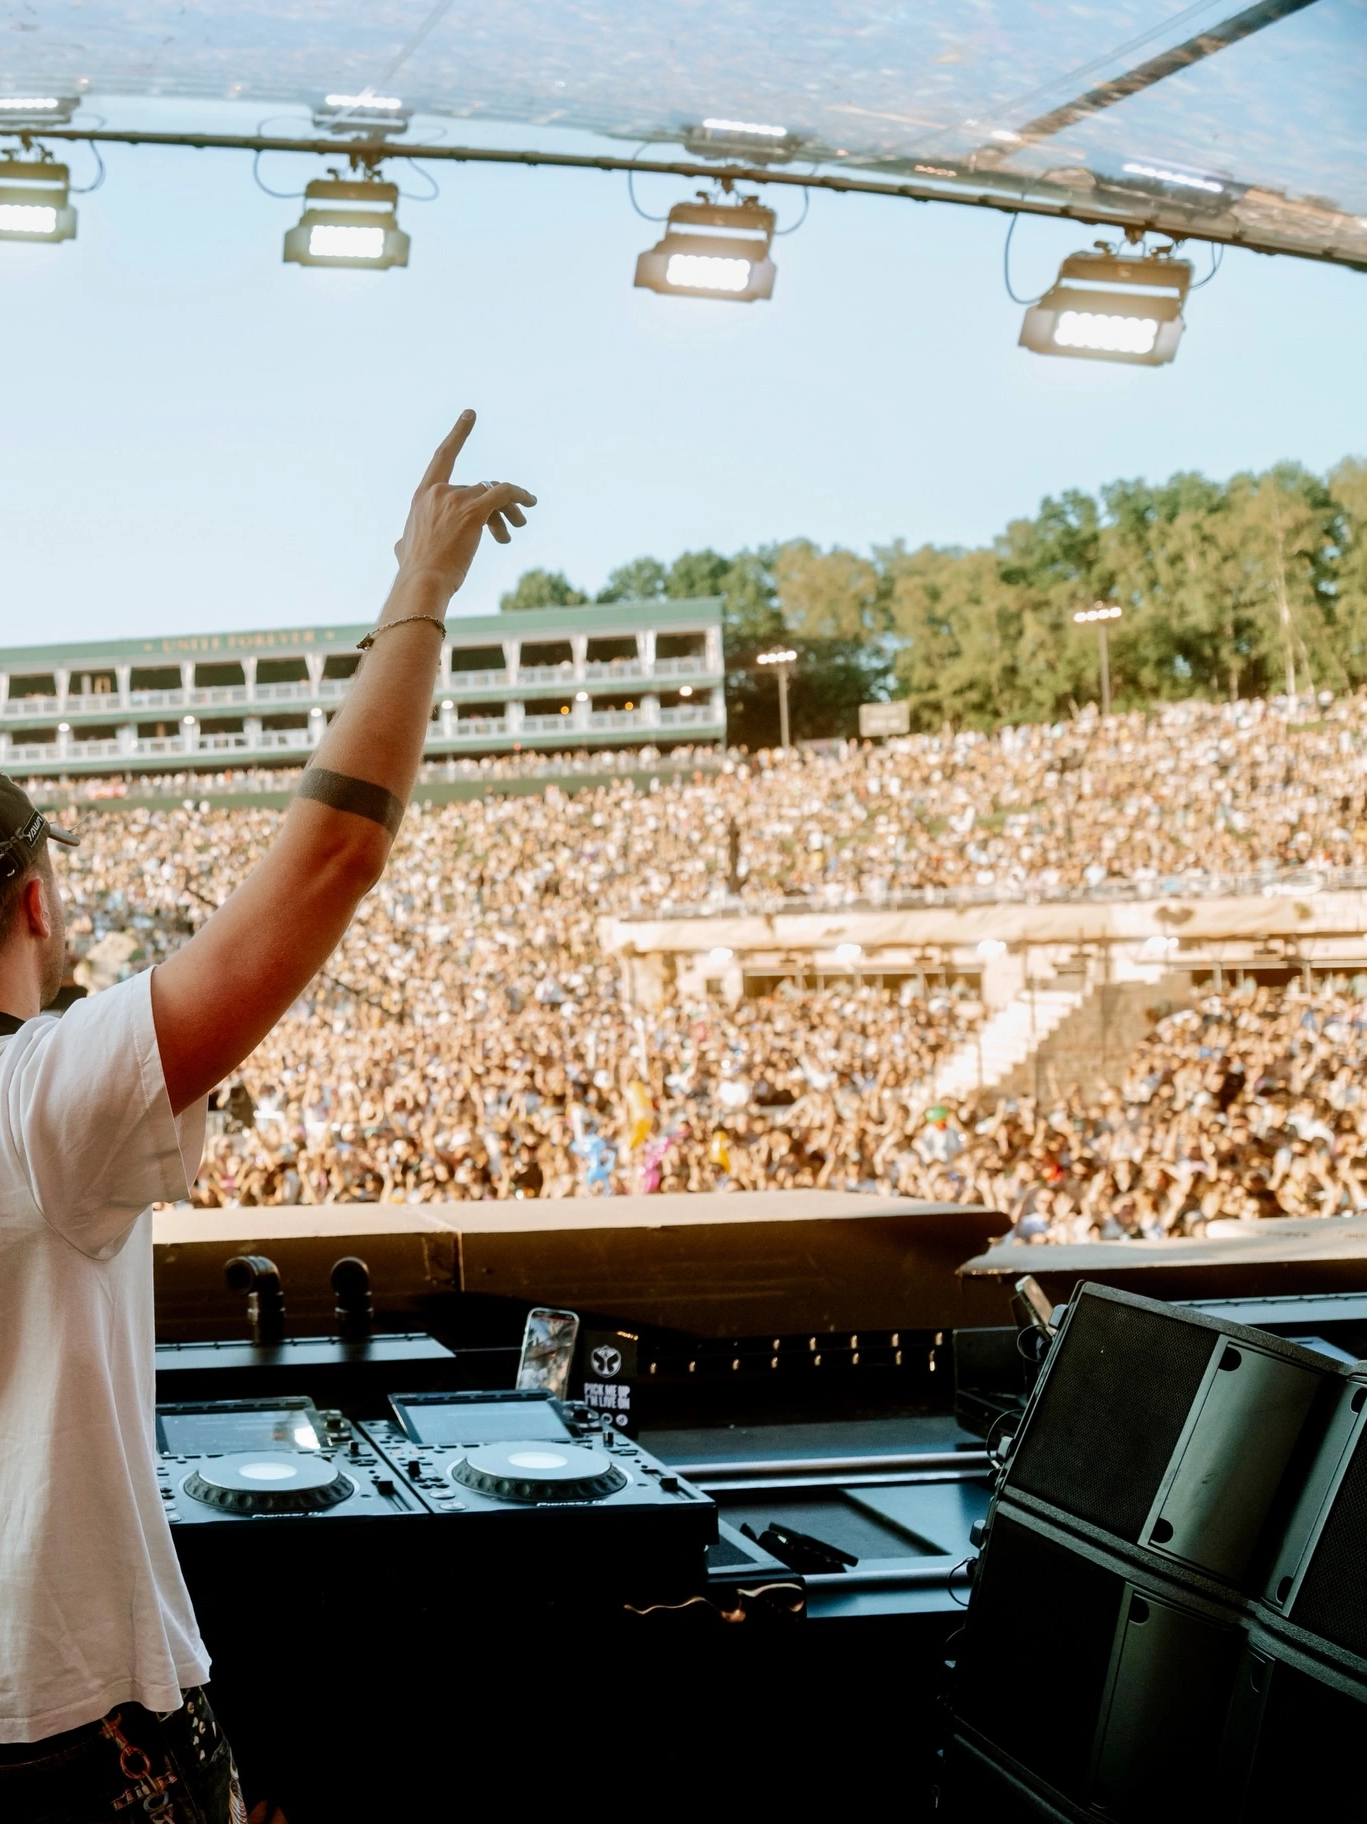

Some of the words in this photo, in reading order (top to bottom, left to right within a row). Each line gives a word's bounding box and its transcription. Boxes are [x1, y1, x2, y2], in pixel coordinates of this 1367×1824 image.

[227, 630, 315, 648] FOREVER
[584, 1382, 604, 1396] PICK
[604, 1384, 617, 1398] ME
[618, 1385, 631, 1399] UP
[599, 1396, 617, 1409] LIVE
[618, 1397, 631, 1411] ON
